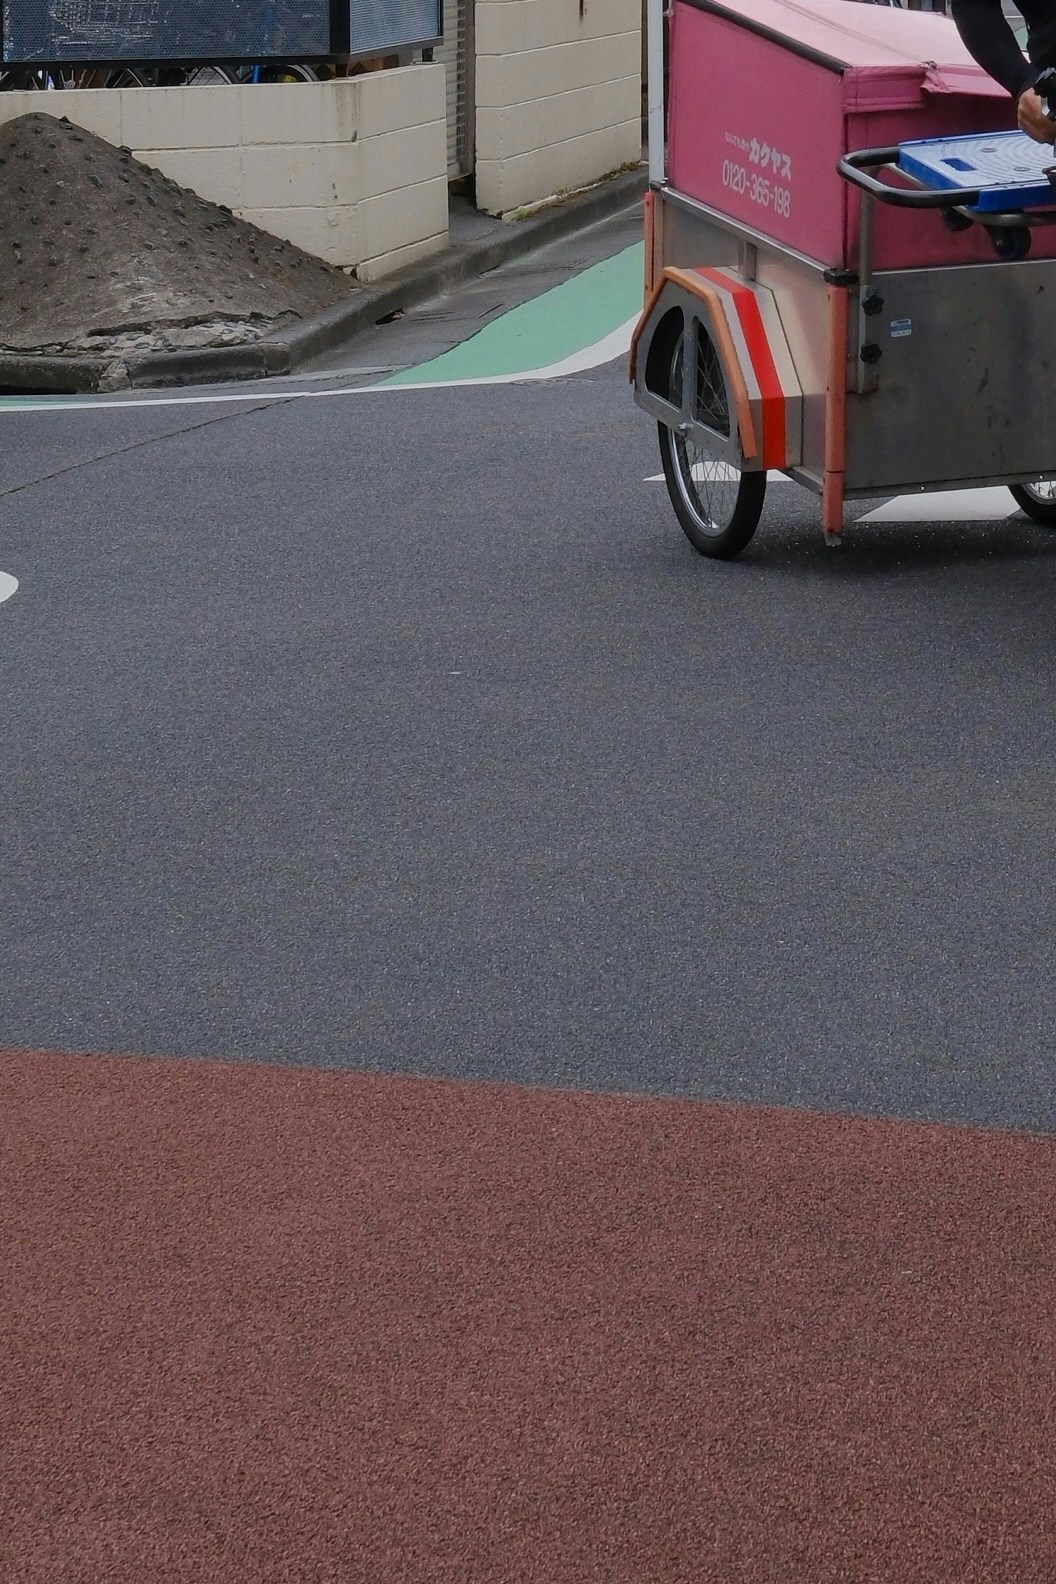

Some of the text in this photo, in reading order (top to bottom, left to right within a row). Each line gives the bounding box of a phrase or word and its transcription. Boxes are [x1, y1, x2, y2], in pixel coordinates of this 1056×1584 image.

[748, 137, 791, 182] カクヤス
[722, 159, 791, 219] 0120-365-198
